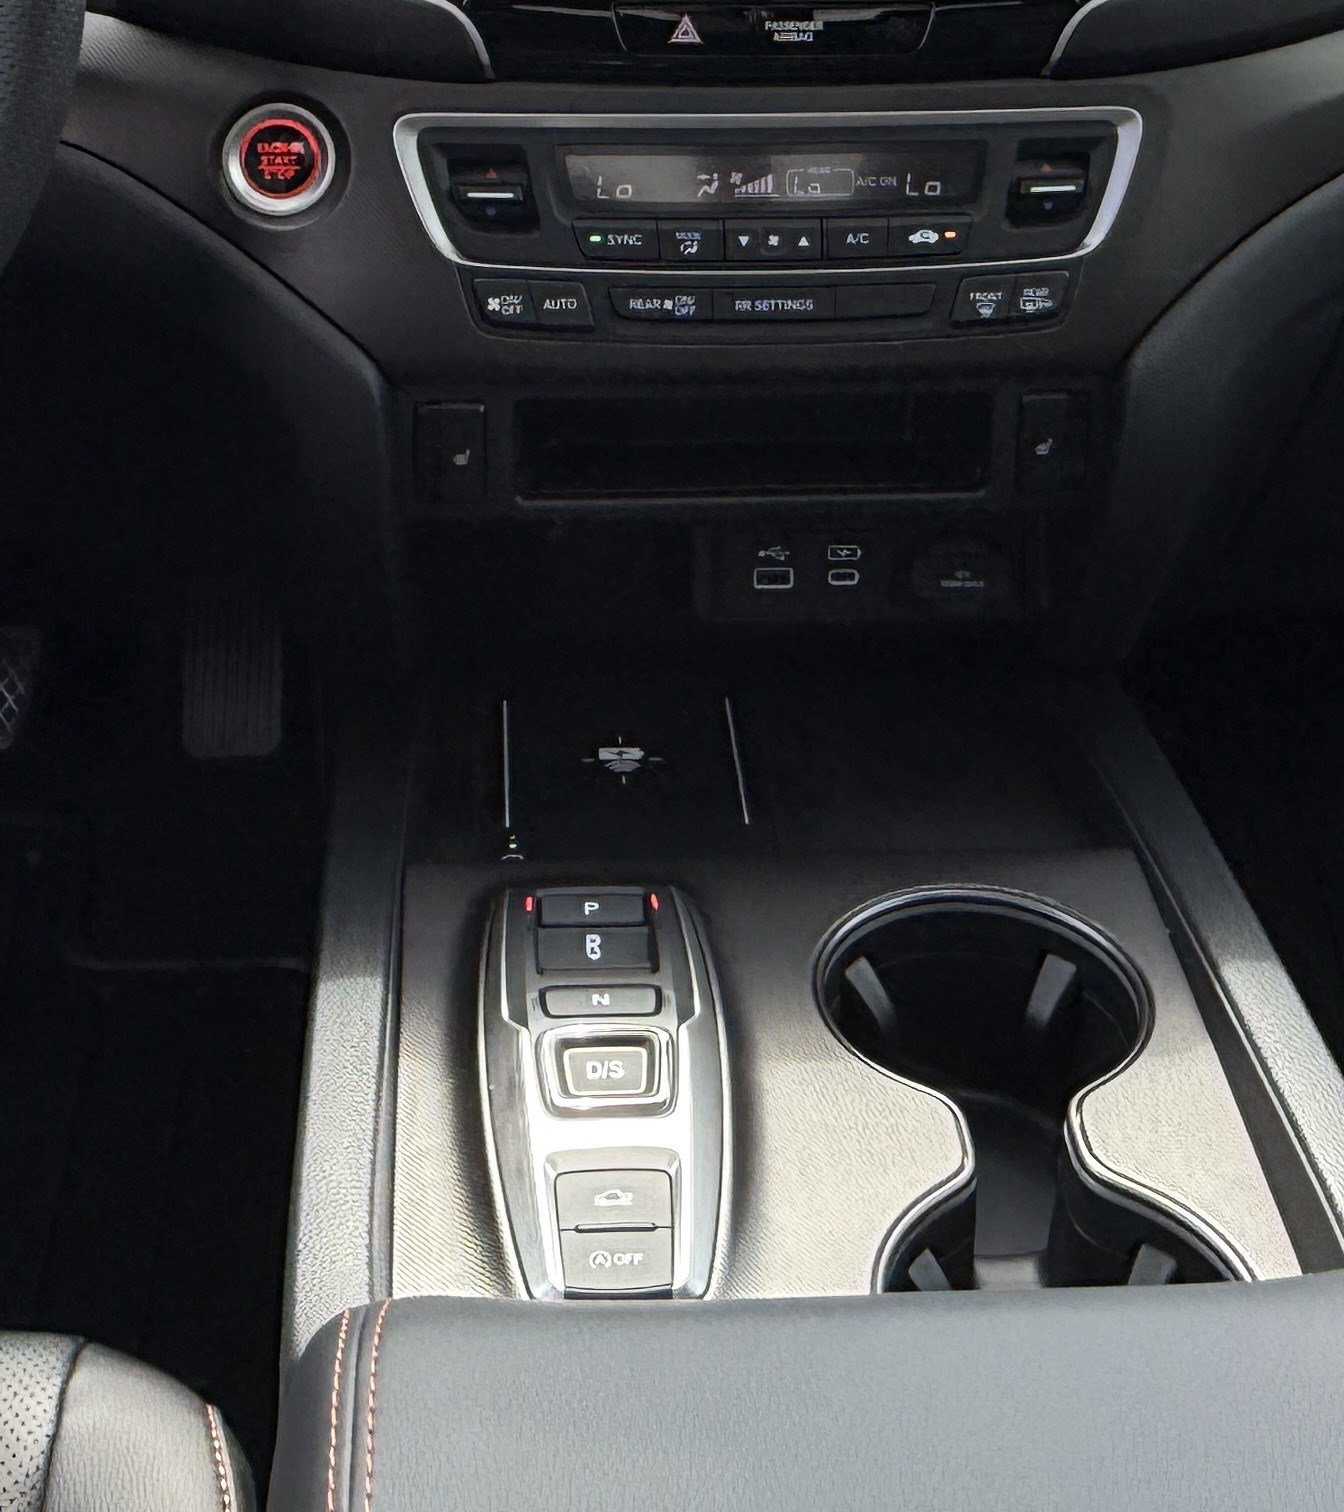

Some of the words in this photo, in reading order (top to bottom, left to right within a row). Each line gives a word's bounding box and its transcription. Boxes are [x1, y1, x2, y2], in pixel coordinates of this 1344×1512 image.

[607, 233, 642, 246] SYNC
[847, 233, 870, 244] A/C
[543, 298, 577, 310] AUTO
[584, 901, 599, 915] P
[592, 994, 611, 1005] N
[585, 1060, 625, 1081] D/S
[613, 1252, 644, 1266] OFF
